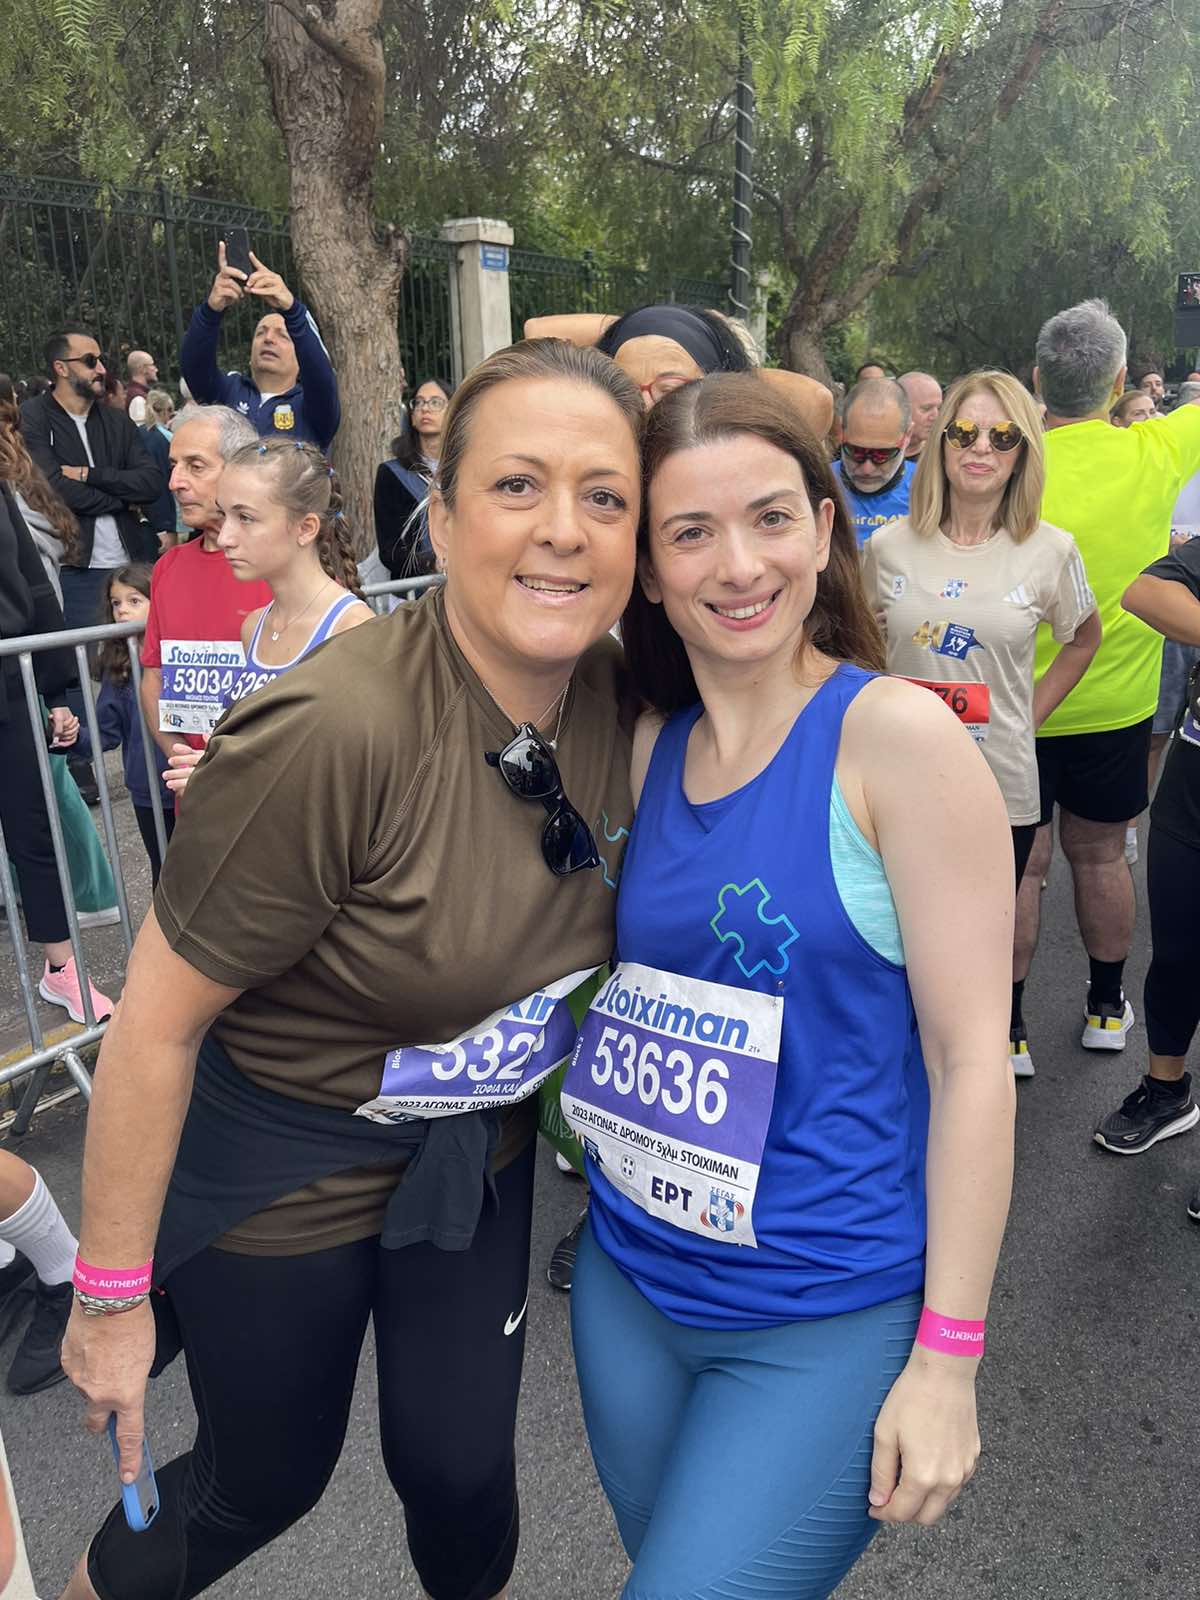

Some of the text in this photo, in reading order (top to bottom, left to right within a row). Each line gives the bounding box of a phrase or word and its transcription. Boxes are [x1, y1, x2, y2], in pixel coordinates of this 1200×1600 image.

[168, 646, 240, 664] Stoiximan
[173, 668, 233, 694] 53034
[596, 973, 750, 1050] Stoiximan
[431, 1028, 545, 1081] 532
[472, 1084, 500, 1095] ΣΟΦΙΑ
[591, 1026, 730, 1125] 53636
[420, 1100, 467, 1110] ΑΓΩΝΑΣ
[571, 1104, 588, 1121] 2023
[588, 1111, 619, 1135] ΑΓΩΝΑΣ
[619, 1126, 656, 1150] ΔΡΟΜΟΥ
[656, 1141, 679, 1161] 5χλμ
[680, 1150, 739, 1180] STOIXIMAN
[651, 1175, 693, 1212] ΕΡΤ
